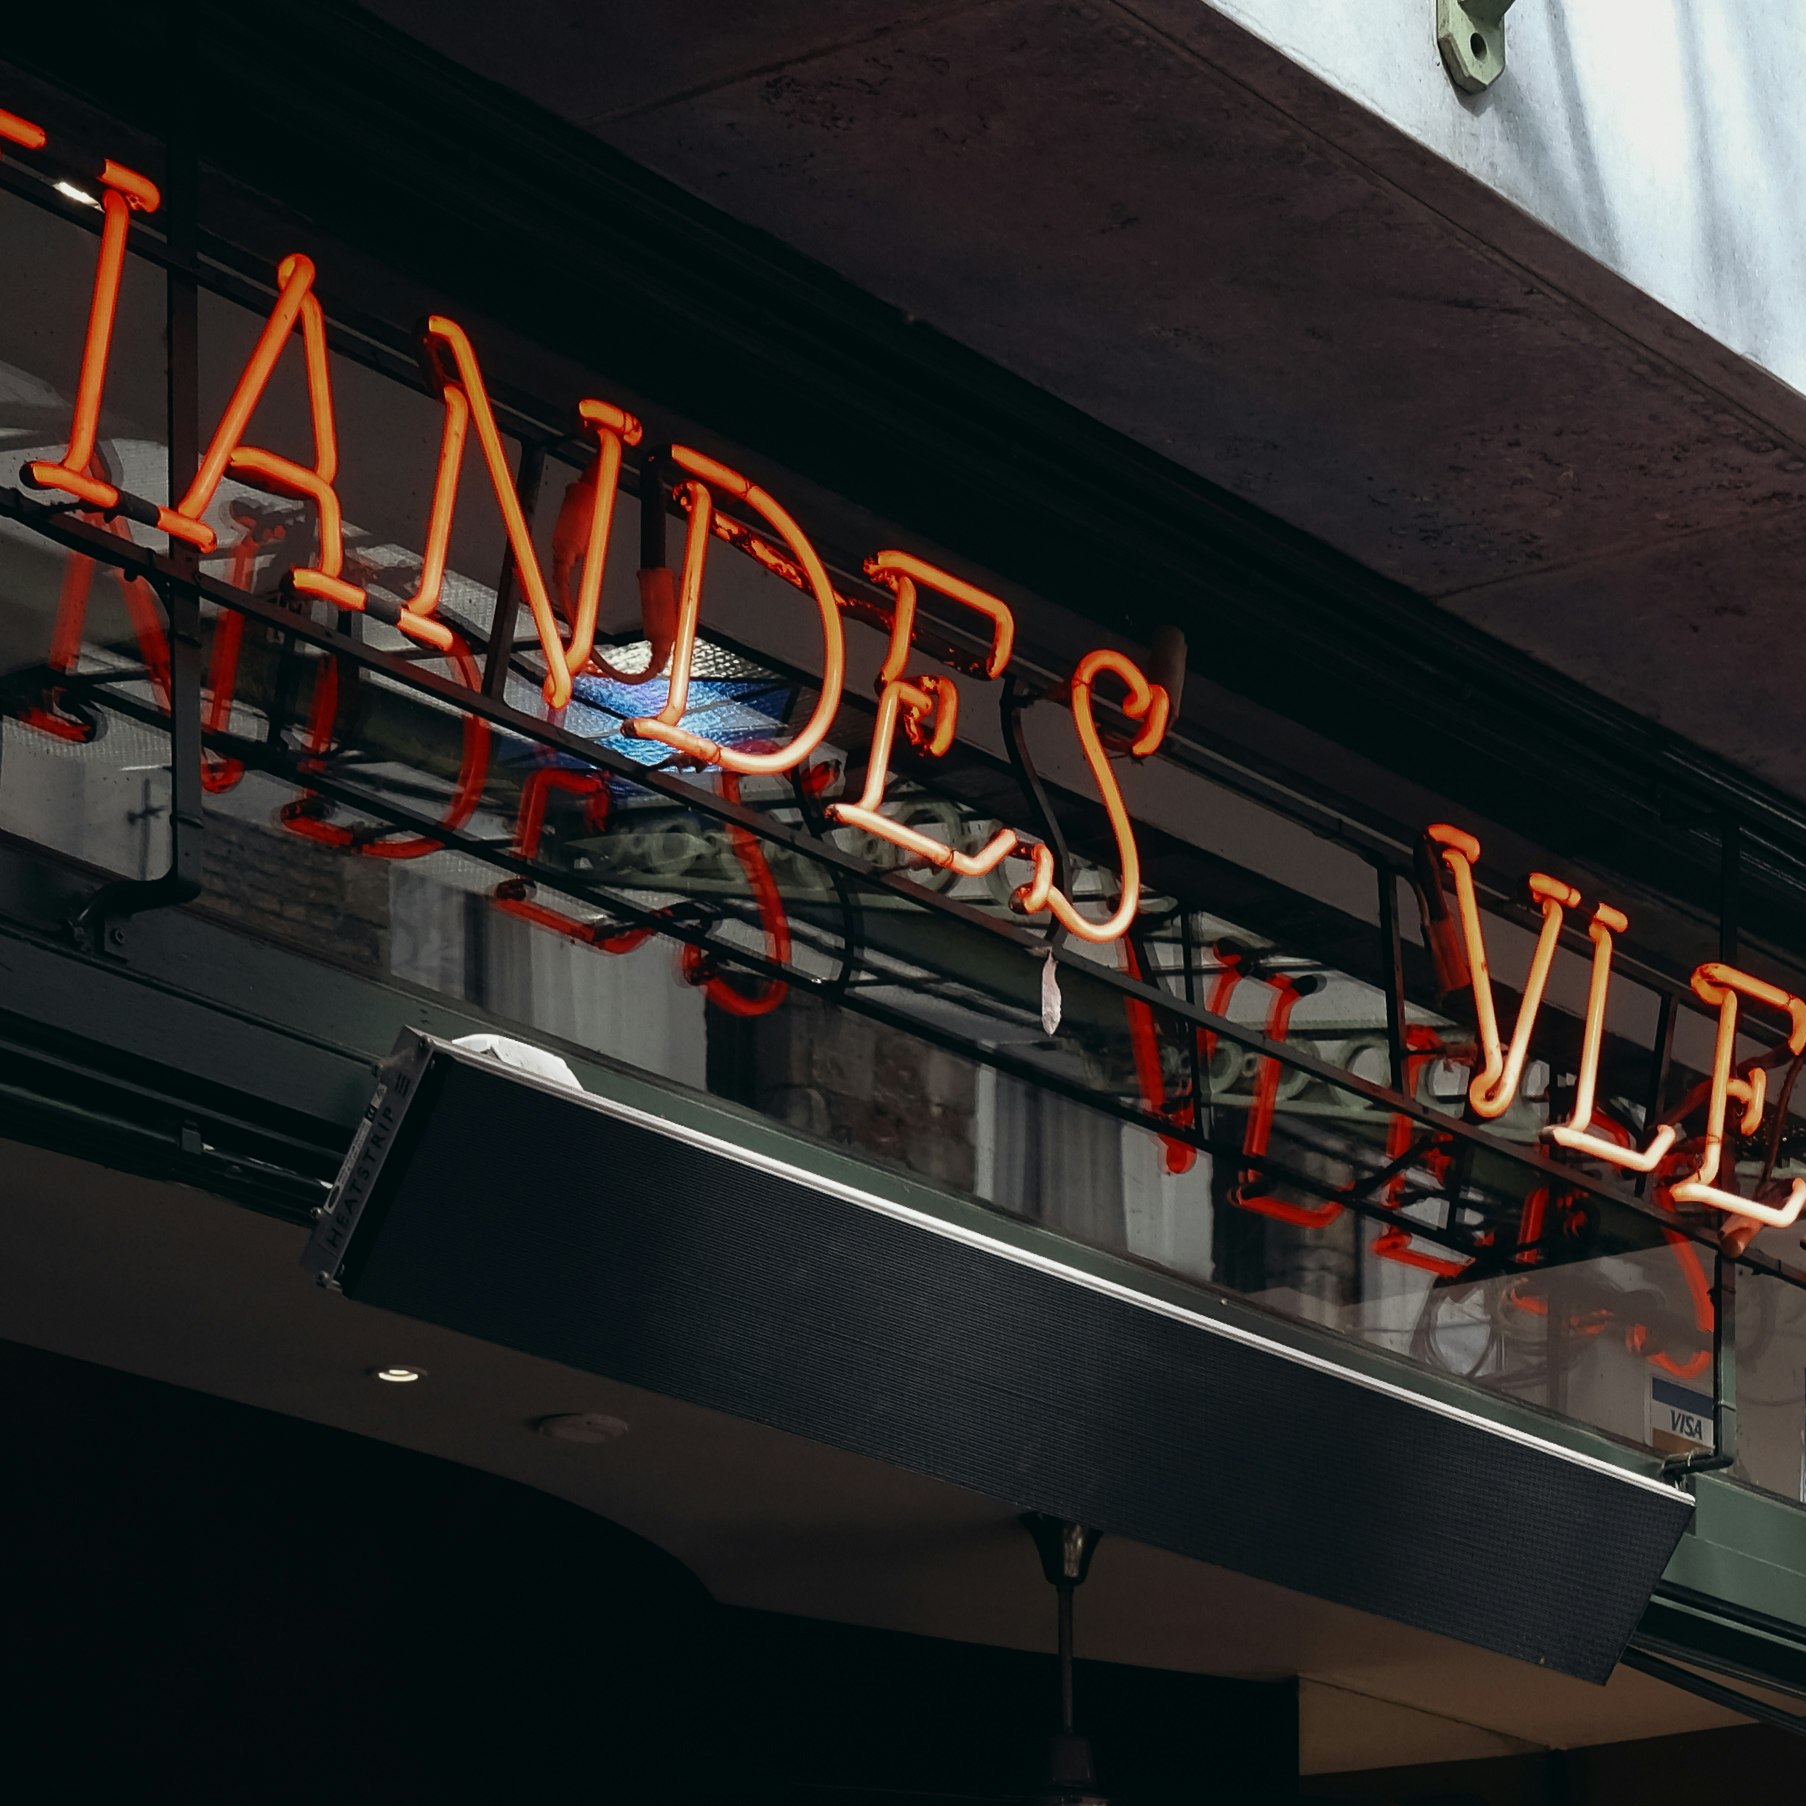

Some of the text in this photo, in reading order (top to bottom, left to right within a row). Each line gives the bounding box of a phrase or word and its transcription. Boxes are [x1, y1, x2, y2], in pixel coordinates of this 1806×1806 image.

[0, 108, 1170, 943] IANDES
[327, 1106, 396, 1249] HEATSTRIP
[1670, 1410, 1703, 1440] VISA
